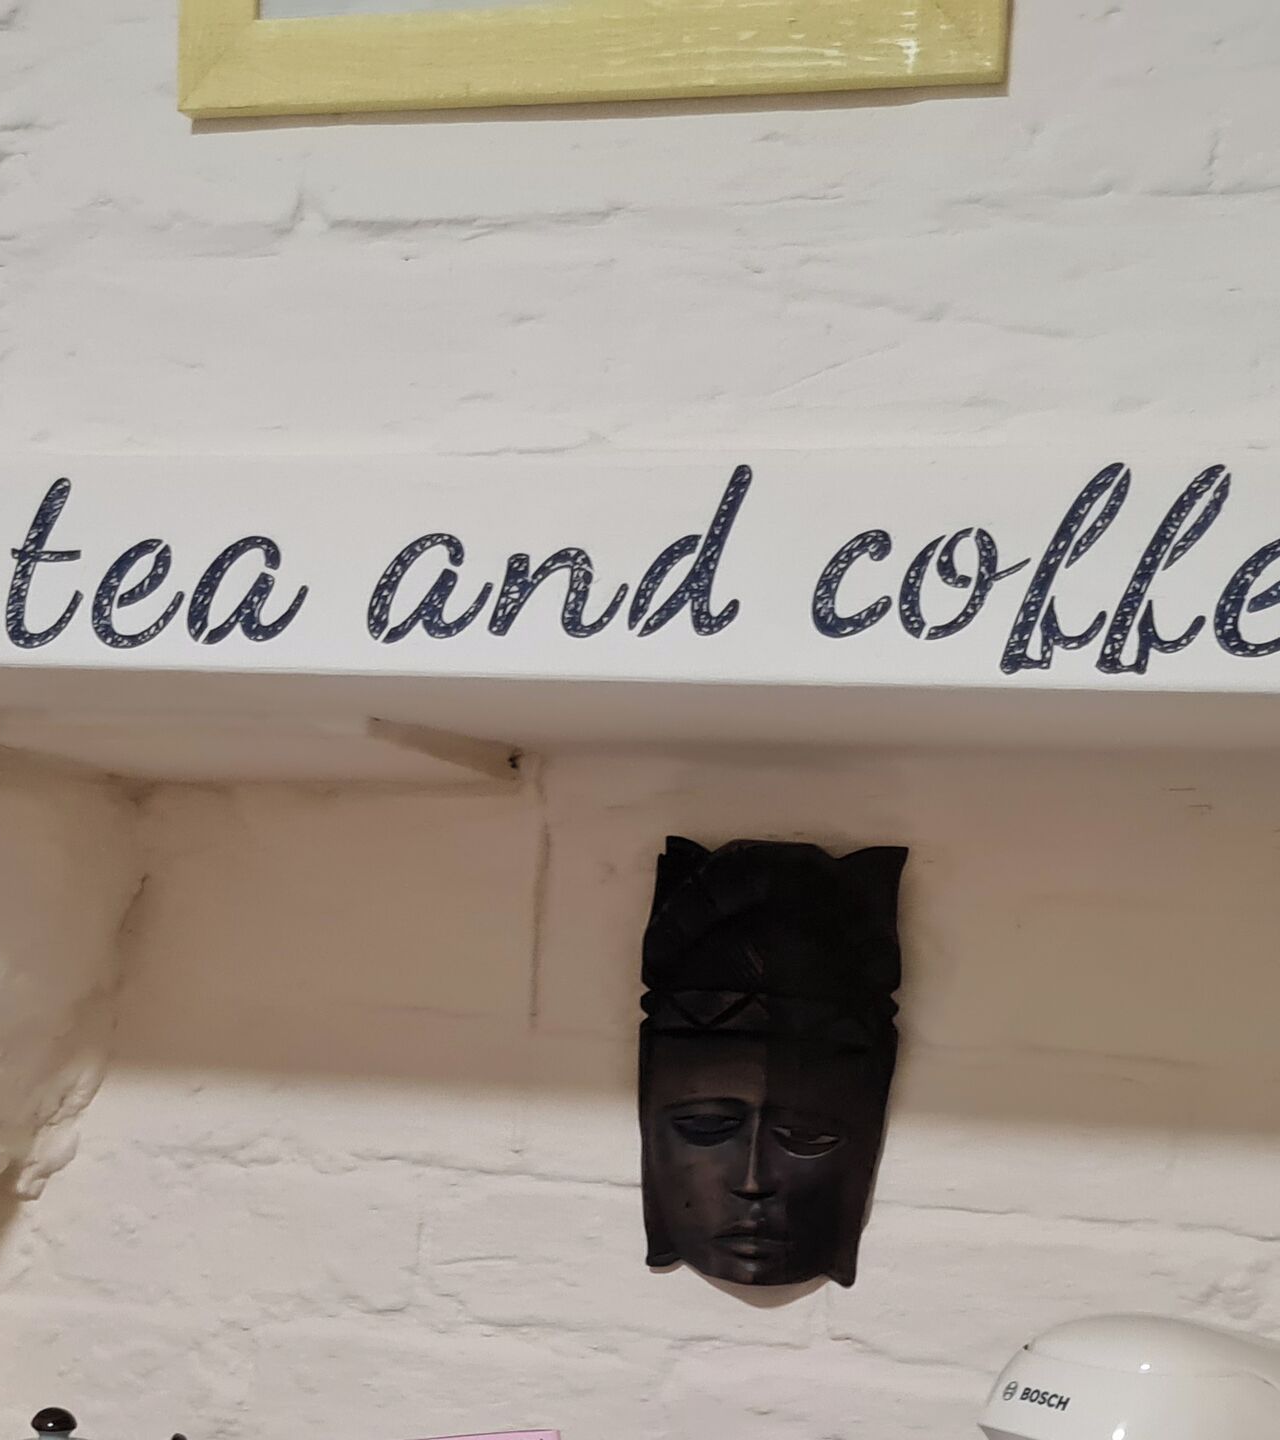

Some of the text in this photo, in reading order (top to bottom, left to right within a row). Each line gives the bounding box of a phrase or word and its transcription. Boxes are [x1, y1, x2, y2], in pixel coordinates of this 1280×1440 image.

[5, 477, 308, 648] tea
[367, 464, 752, 643] and
[1020, 1387, 1070, 1411] BOSCH
